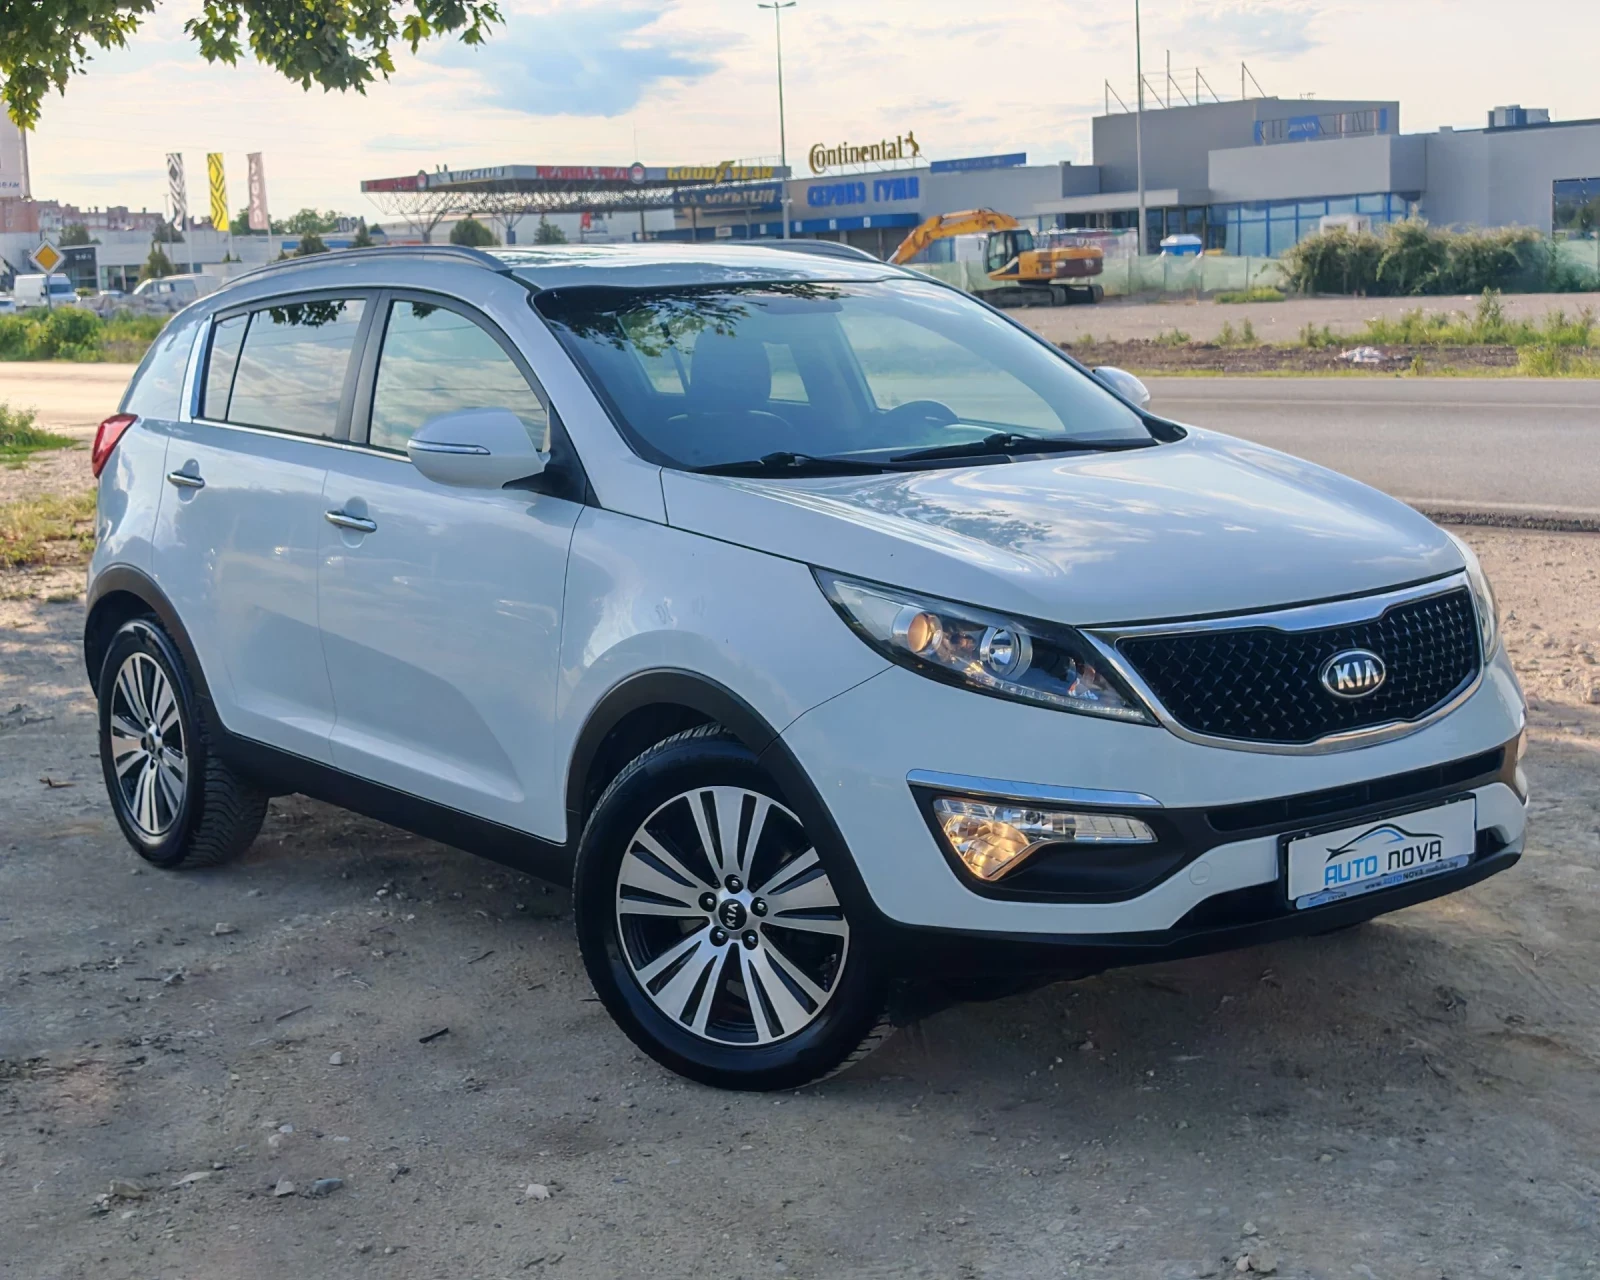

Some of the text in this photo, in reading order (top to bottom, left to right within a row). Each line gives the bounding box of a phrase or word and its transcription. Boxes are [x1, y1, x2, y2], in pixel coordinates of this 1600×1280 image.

[808, 135, 903, 175] Continental
[1333, 659, 1380, 690] KIA
[1324, 840, 1443, 886] AUTO NOVA
[726, 903, 738, 928] KIA
